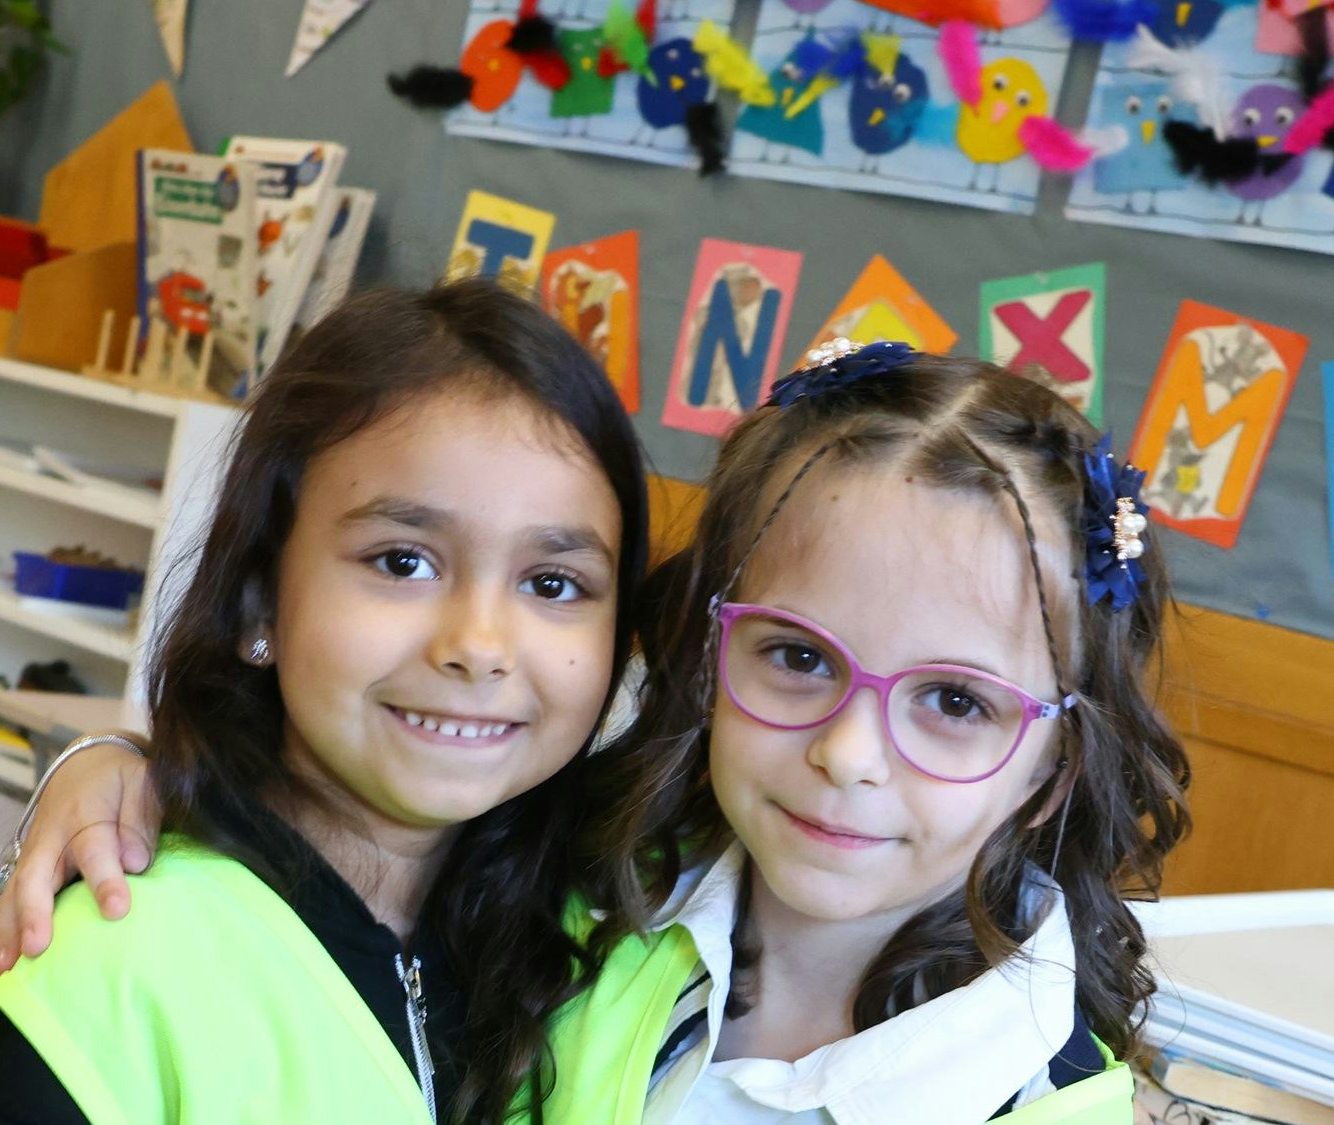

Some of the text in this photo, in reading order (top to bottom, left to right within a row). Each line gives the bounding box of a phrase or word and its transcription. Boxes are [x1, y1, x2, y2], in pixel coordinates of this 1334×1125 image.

[687, 278, 783, 407] N
[992, 288, 1092, 385] X
[1137, 338, 1287, 520] M
